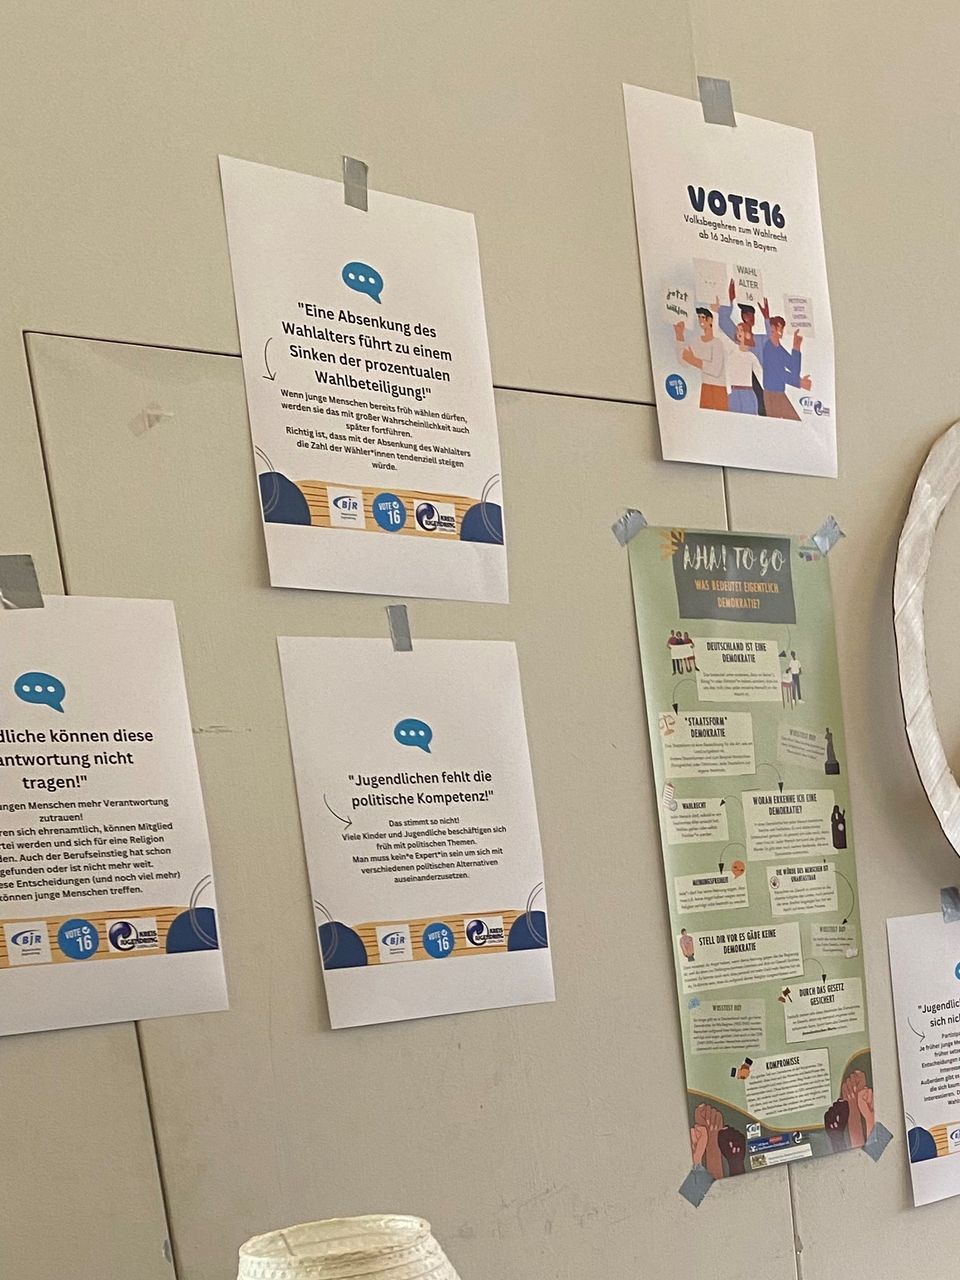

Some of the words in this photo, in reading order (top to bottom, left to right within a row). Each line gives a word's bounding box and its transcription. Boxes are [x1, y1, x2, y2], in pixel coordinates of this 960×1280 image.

[688, 185, 785, 228] VOTE16
[684, 214, 737, 232] Volksbegehren
[739, 226, 751, 235] zum
[753, 228, 787, 242] Wahlrecht
[699, 230, 708, 239] ab
[711, 232, 718, 240] 16
[721, 234, 744, 246] Jahren
[746, 239, 752, 247] in
[754, 241, 777, 252] Bayern
[737, 265, 757, 276] WAHL
[739, 280, 758, 289] ALTER
[298, 302, 334, 320] "Eine
[338, 310, 411, 336] Absenkung
[414, 324, 436, 337] des
[282, 321, 355, 345] Wahlalters
[359, 334, 392, 352] führt
[395, 343, 409, 354] zu
[413, 345, 452, 361] einem
[290, 345, 335, 363] Sinken
[339, 354, 361, 367] der
[365, 359, 450, 381] prozentualen
[315, 371, 431, 401] Wahlbeteiligung!"
[281, 389, 303, 399] Wenn
[305, 393, 327, 403] junge
[329, 396, 368, 408] Menschen
[370, 402, 396, 412] bereits
[397, 406, 412, 415] früh
[414, 409, 439, 419] wählen
[441, 412, 467, 423] dürfen,
[346, 423, 370, 433] später
[372, 426, 412, 437] fortführen.
[286, 426, 314, 438] Richtig
[315, 430, 328, 439] ist,
[329, 432, 347, 441] dass
[349, 435, 361, 443] mit
[363, 436, 375, 444] der
[377, 438, 417, 451] Absenkung
[419, 444, 432, 452] des
[433, 445, 471, 457] Wahlalters
[388, 511, 400, 524] 16
[695, 580, 709, 590] WAS
[712, 580, 742, 591] BEDEUTET
[745, 582, 778, 593] EIGENTLICH
[717, 597, 760, 608] DEMOKRATIE?
[707, 642, 744, 651] DEUTSCHLAND
[755, 643, 766, 651] EINE
[722, 654, 755, 662] DEMOKRATIE
[50, 730, 109, 743] können
[114, 729, 153, 742] diese
[691, 728, 725, 738] DEMOKRATIE
[94, 752, 134, 765] nicht
[22, 775, 87, 792] tragen!"
[349, 773, 439, 788] "Jugendlichen
[442, 772, 471, 783] fehlt
[474, 771, 492, 782] die
[29, 801, 76, 810] Menschen
[78, 800, 101, 808] mehr
[103, 799, 169, 807] Verantwortung
[352, 793, 414, 809] politische
[417, 790, 493, 806] Kompetenz!"
[769, 806, 802, 815] DEMOKRATIE?
[39, 814, 83, 822] zutrauen!
[389, 819, 402, 827] Das
[404, 818, 428, 826] stimmt
[363, 832, 386, 840] Kinder
[404, 828, 447, 839] Jugendliche
[448, 827, 491, 836] beschäftigen
[17, 840, 51, 849] werden
[54, 839, 71, 847] und
[94, 837, 107, 845] für
[109, 836, 128, 844] eine
[130, 835, 164, 844] Religion
[1, 866, 44, 878] gefunden
[47, 865, 68, 873] oder
[84, 862, 106, 871] nicht
[361, 864, 414, 874] verschiedenen
[416, 862, 455, 871] politischen
[456, 859, 498, 868] Alternativen
[394, 872, 469, 883] auseinanderzusetzen.
[34, 890, 60, 901] junge
[62, 887, 108, 898] Menschen
[110, 886, 143, 895] treffen.
[65, 928, 82, 939] VOTE
[699, 935, 714, 946] STELL
[716, 935, 725, 943] DIR
[727, 933, 737, 942] VOR
[739, 932, 745, 941] ES
[747, 930, 760, 940] GÄBE
[762, 929, 776, 938] KEINE
[76, 935, 92, 952] 16
[437, 937, 449, 951] 16
[724, 942, 756, 954] DEMOKRATIE
[800, 987, 815, 997] DURCH
[817, 986, 826, 995] DAS
[827, 983, 844, 993] GESETZ
[810, 995, 835, 1006] GESICHERT
[930, 1017, 946, 1027] sich
[766, 1057, 799, 1070] KOMPROMISSE
